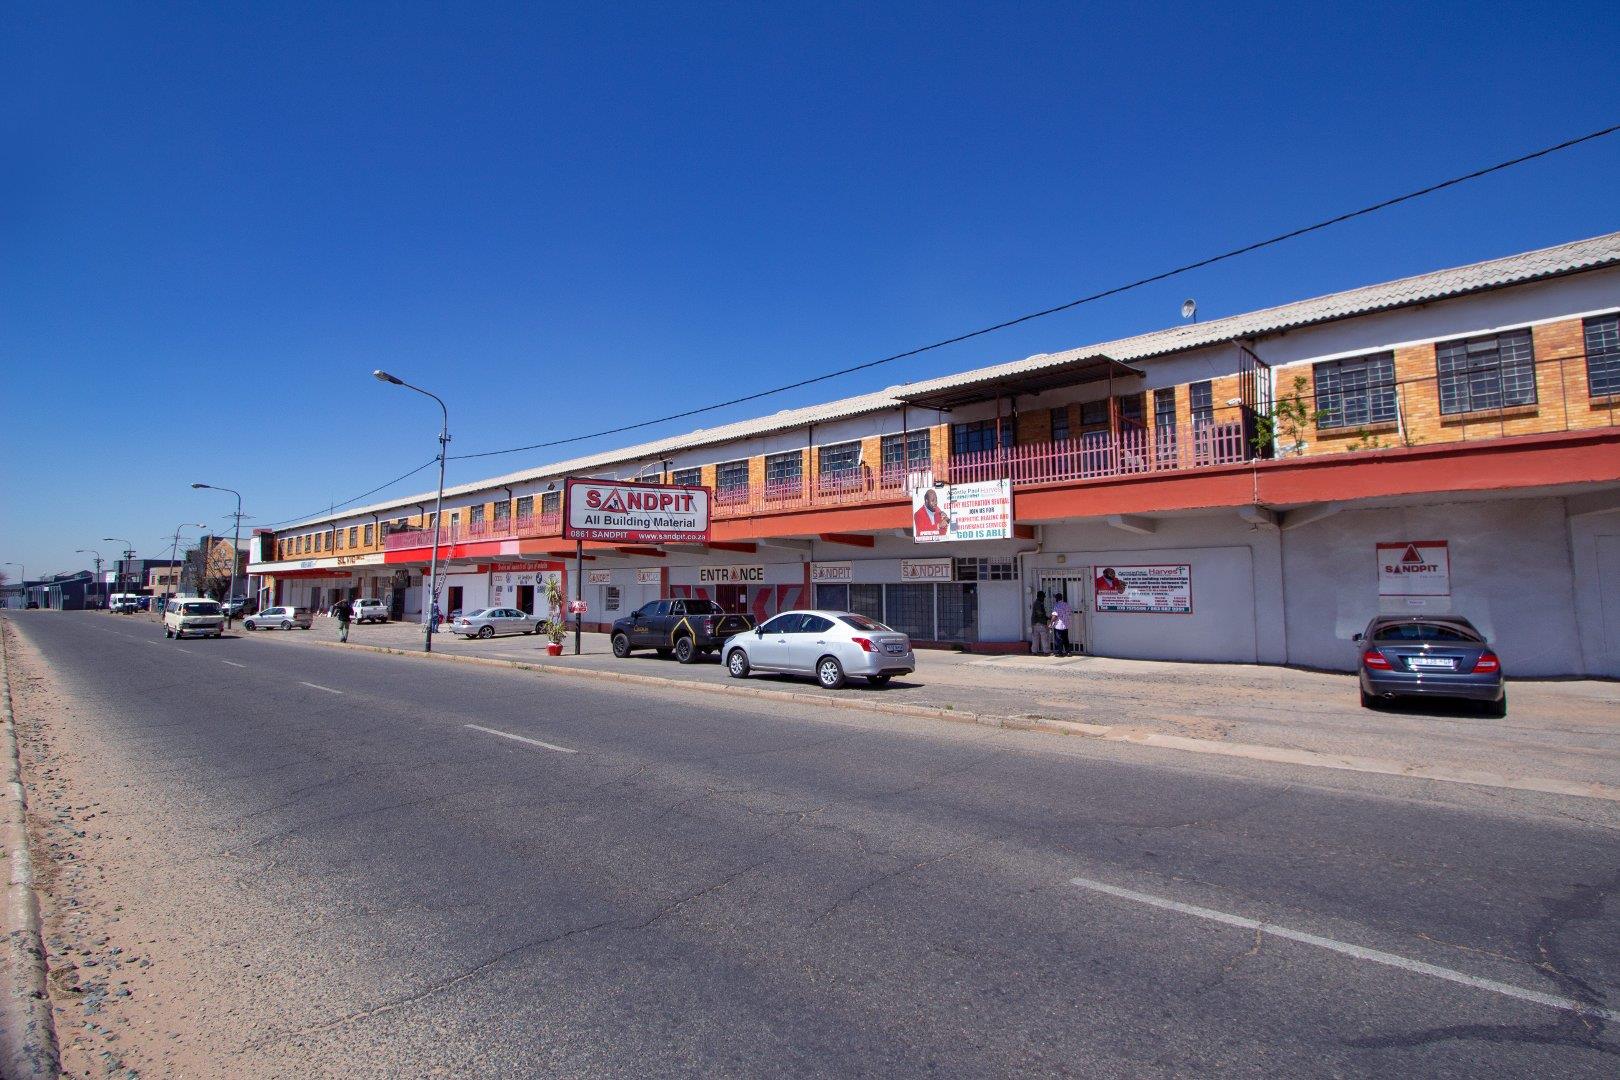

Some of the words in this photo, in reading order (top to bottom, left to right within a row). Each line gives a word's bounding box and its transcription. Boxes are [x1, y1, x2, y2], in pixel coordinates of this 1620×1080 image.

[585, 515, 600, 525] All
[604, 515, 651, 528] Building
[654, 517, 695, 528] Material
[592, 531, 628, 539] SANDPIT
[957, 530, 973, 539] GOD
[976, 530, 984, 538] IS
[986, 529, 1007, 537] ABLE
[1385, 565, 1438, 574] SANDPIT
